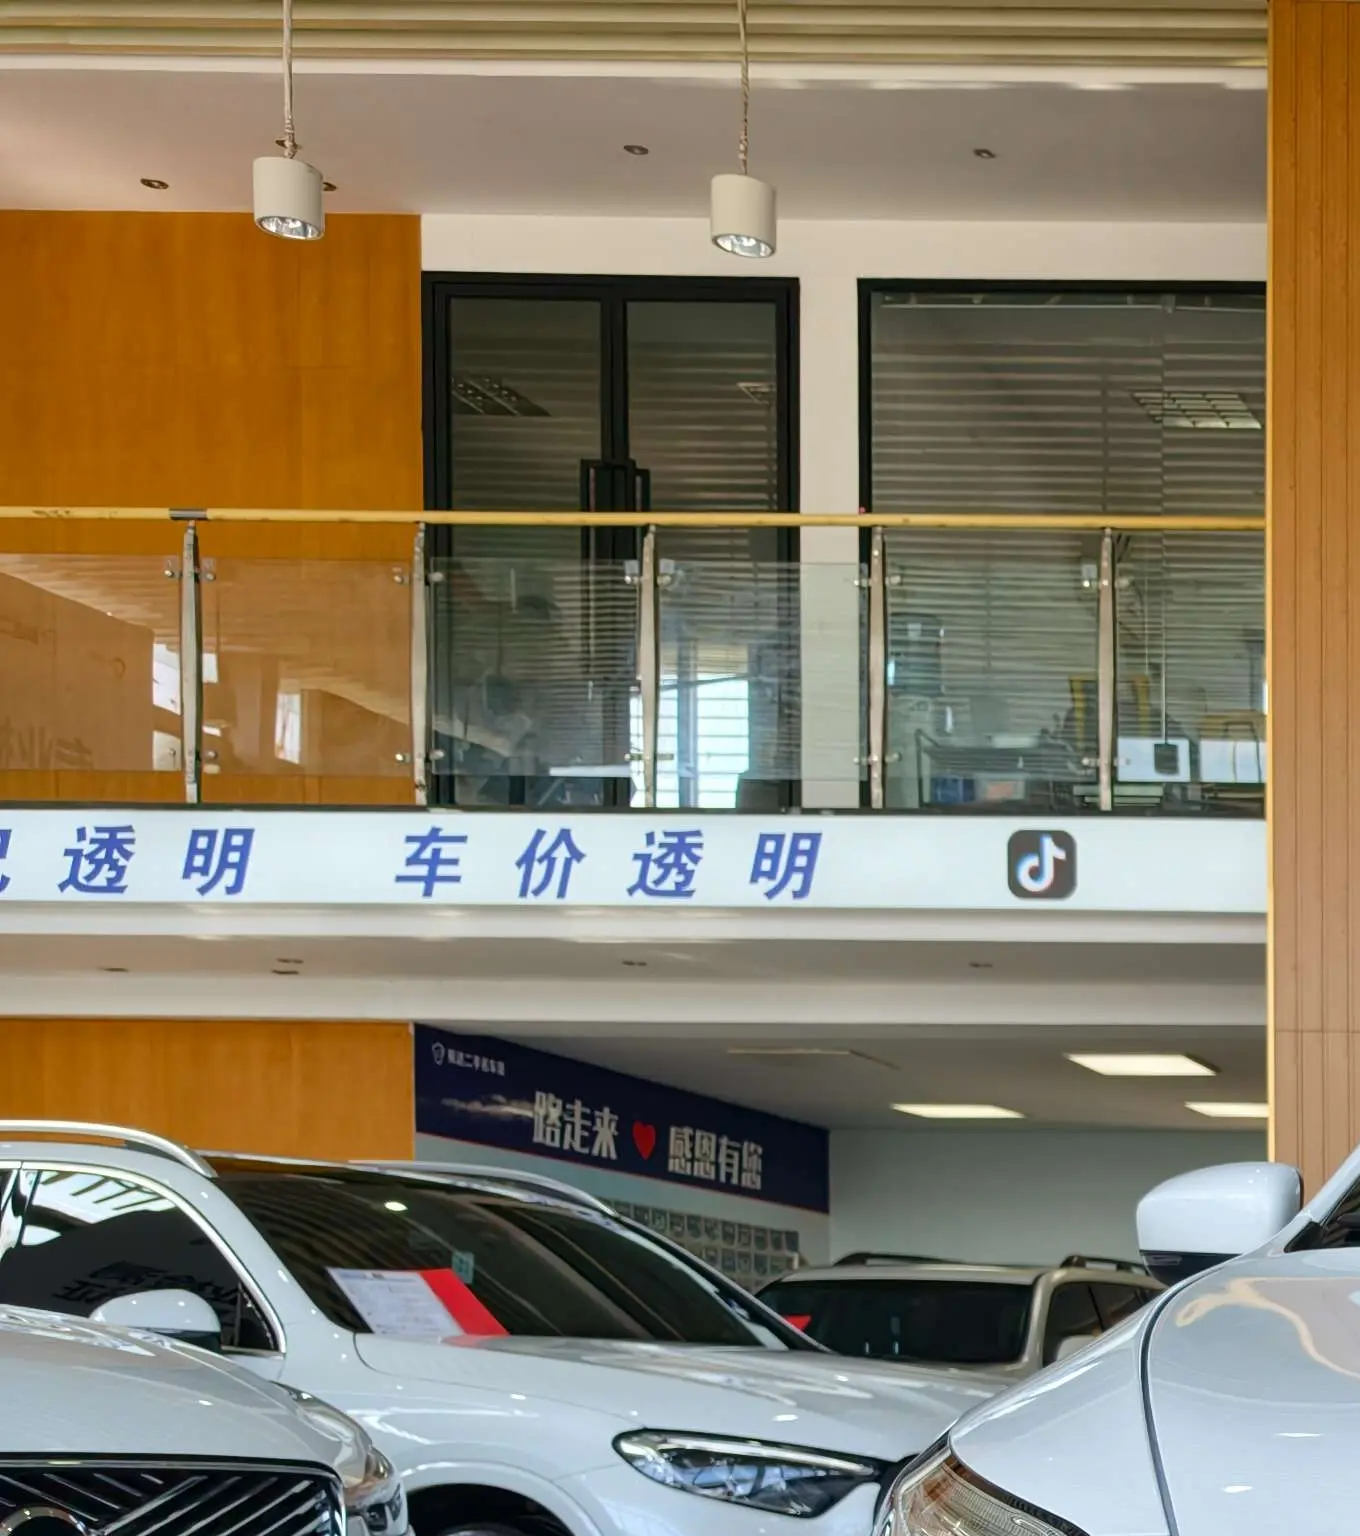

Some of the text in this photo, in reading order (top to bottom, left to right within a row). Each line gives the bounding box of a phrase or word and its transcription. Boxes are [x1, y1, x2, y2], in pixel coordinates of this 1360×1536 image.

[0, 824, 822, 900] 透明 车价透明
